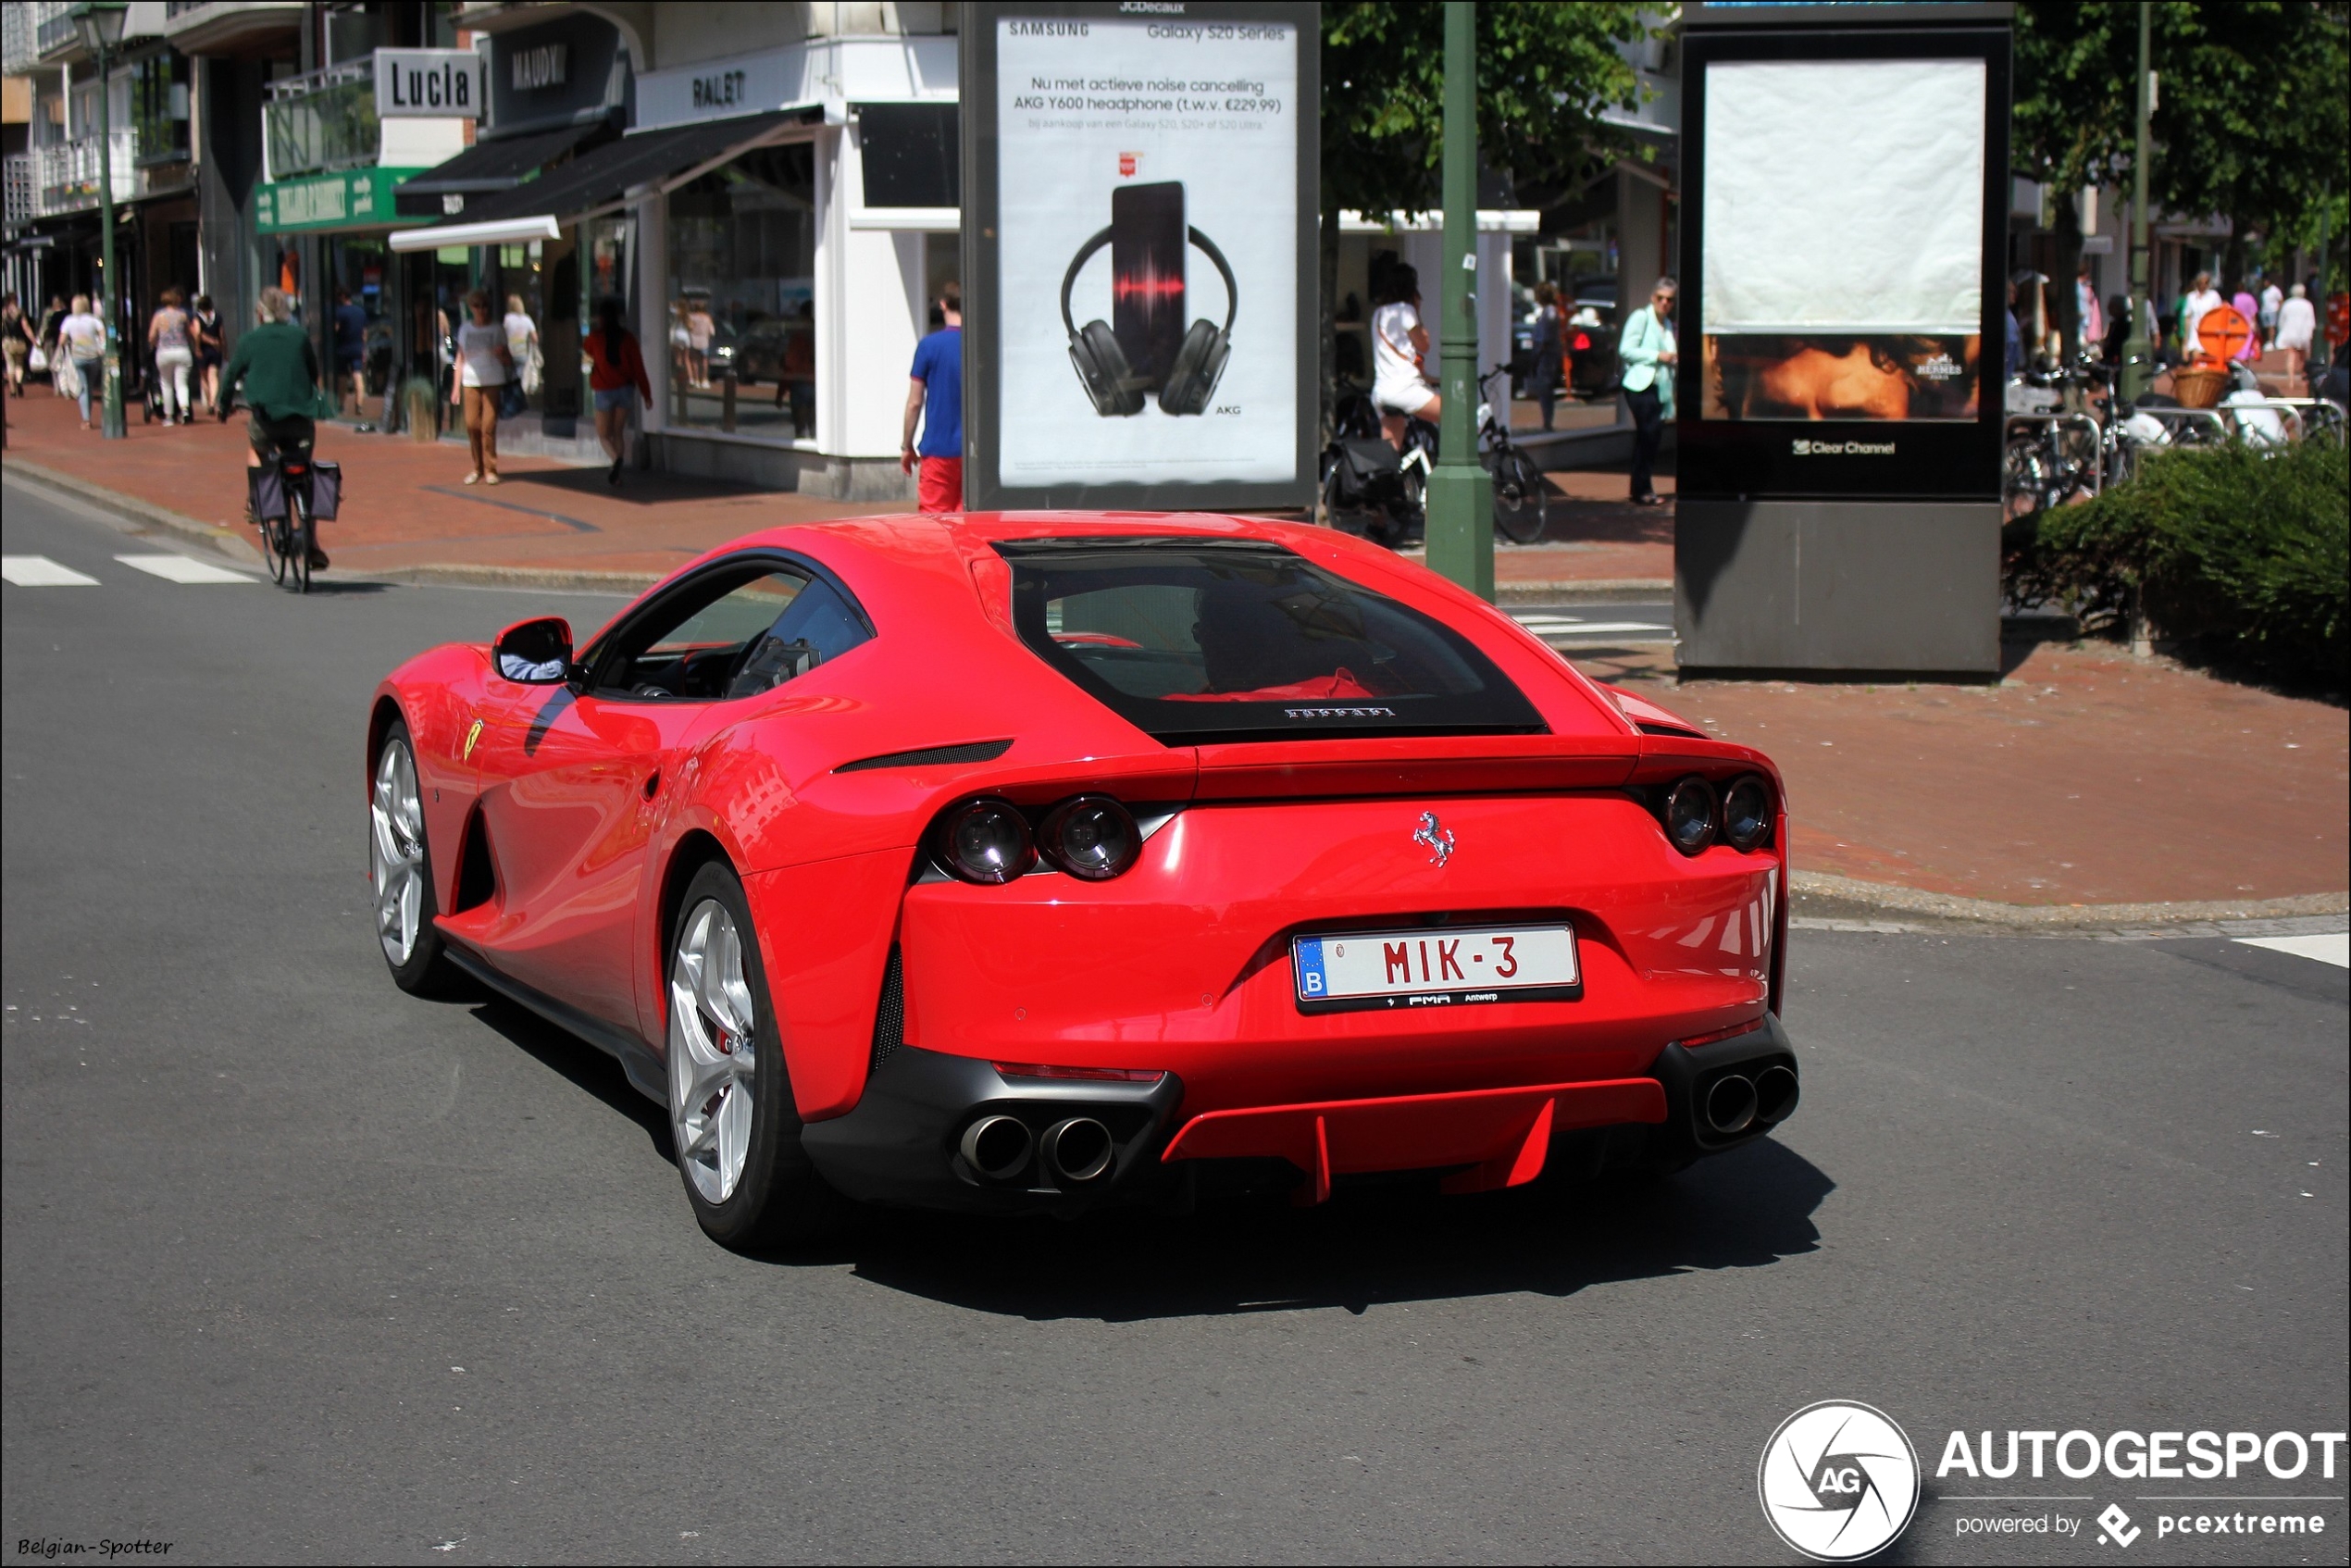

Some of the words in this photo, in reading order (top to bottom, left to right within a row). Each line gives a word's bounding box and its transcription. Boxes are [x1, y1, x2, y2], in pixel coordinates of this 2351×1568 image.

[1118, 2, 1185, 13] JCDecaux
[1010, 22, 1089, 36] SAMSUNG
[1148, 25, 1202, 43] Galaxy
[1208, 25, 1234, 40] S20
[1238, 25, 1286, 40] Series
[392, 61, 469, 106] Lucia
[692, 70, 745, 108] RALET
[1031, 78, 1051, 90] Nu
[1055, 78, 1085, 90] met
[1088, 76, 1143, 91] actieve
[1147, 78, 1186, 92] noise
[1190, 79, 1264, 96] cancelling
[1014, 97, 1044, 109] AKG
[1049, 97, 1084, 109] Y600
[1088, 97, 1173, 113] headphone
[1176, 97, 1221, 112] (t.w.v.
[1125, 118, 1156, 130] Galaxy
[1216, 405, 1241, 415] AKG
[1811, 441, 1844, 454] Clear
[1846, 441, 1896, 454] Channel
[1383, 936, 1518, 985] MIK-3
[1306, 972, 1323, 992] B
[1465, 993, 1498, 1002] Antwerp
